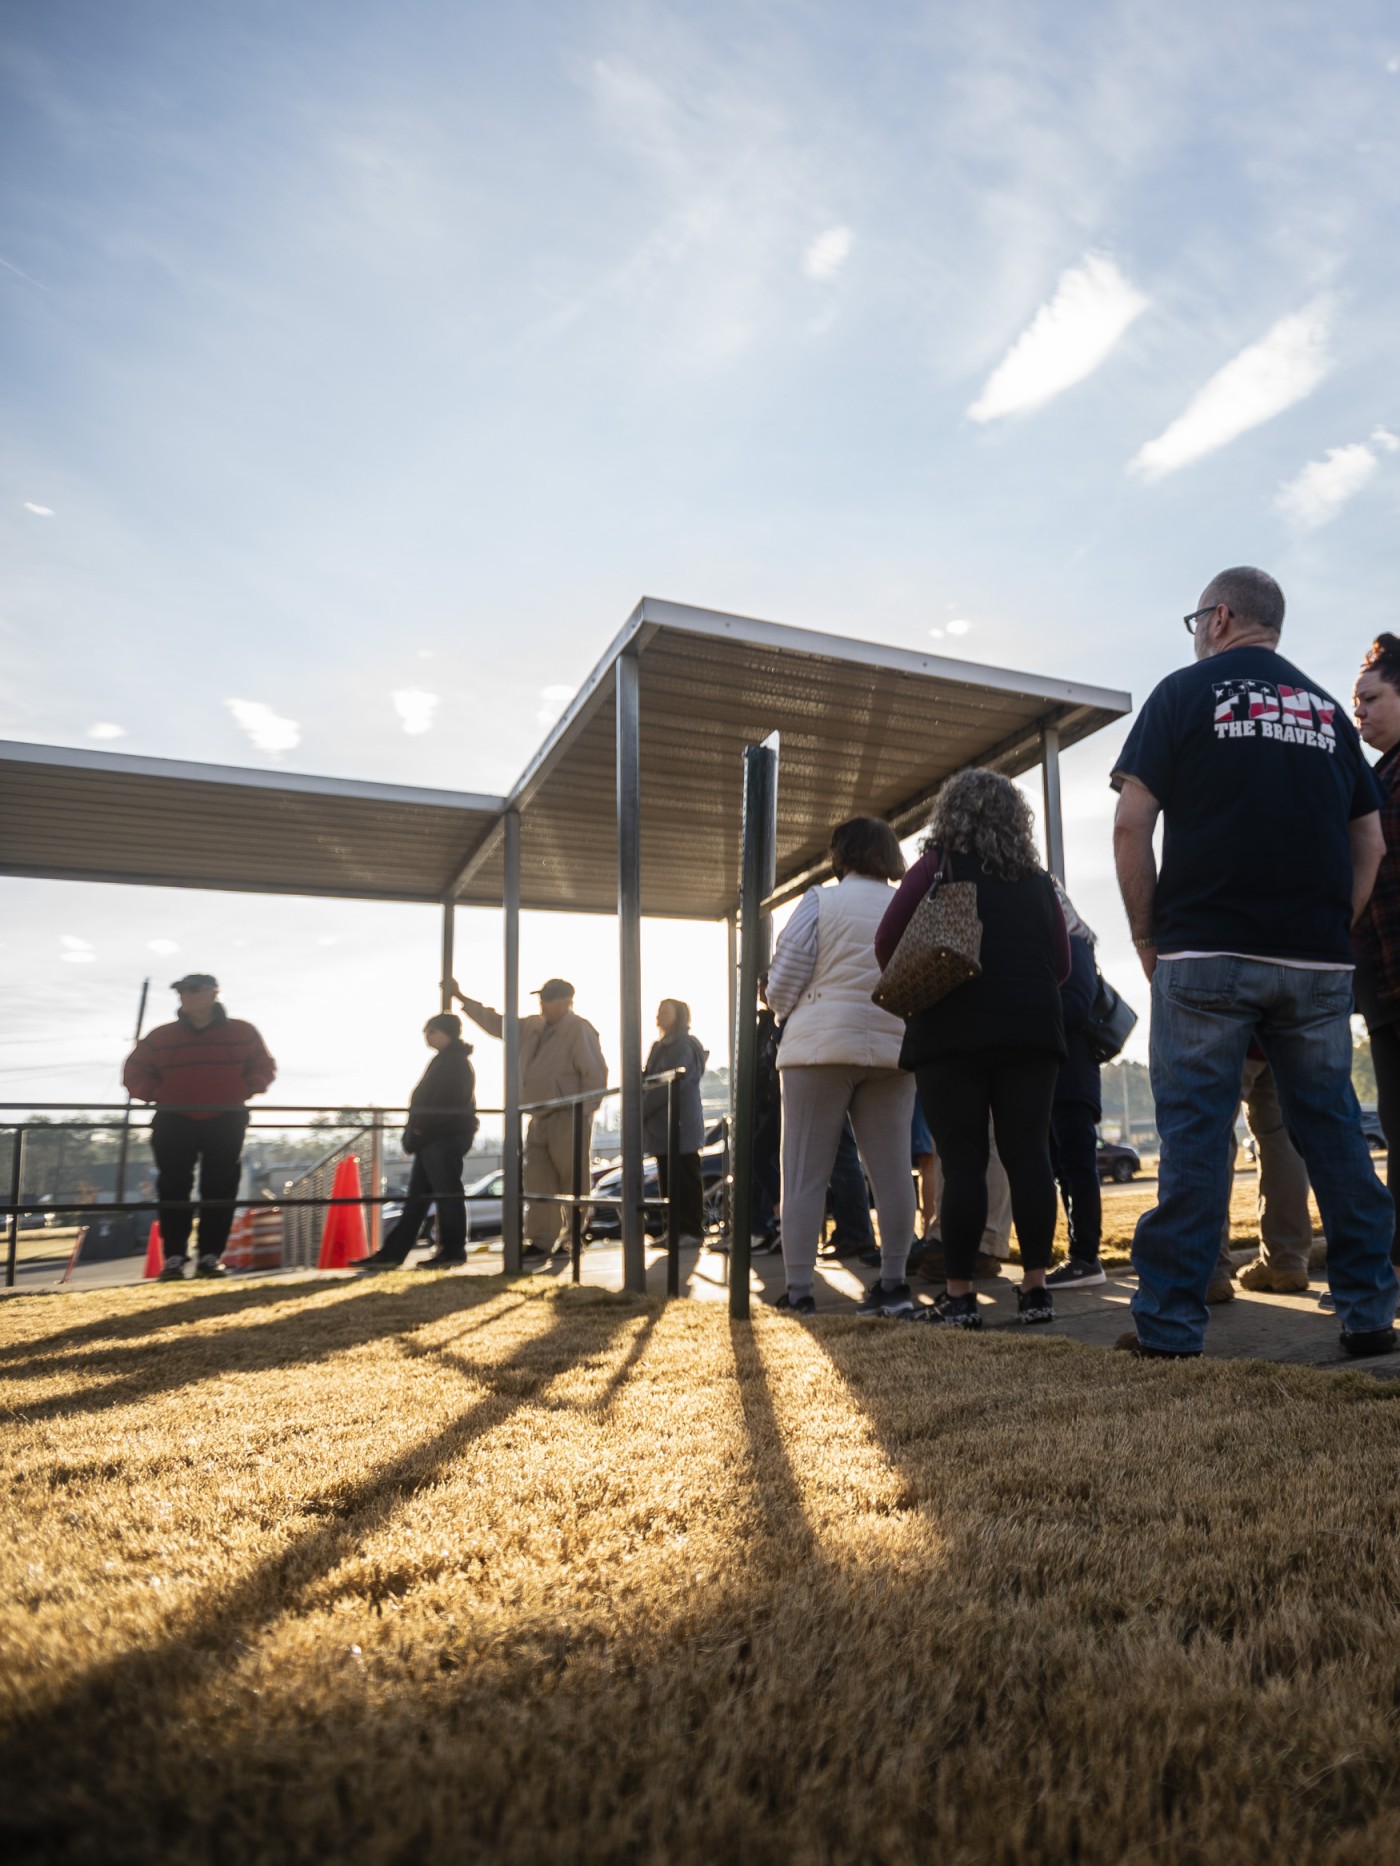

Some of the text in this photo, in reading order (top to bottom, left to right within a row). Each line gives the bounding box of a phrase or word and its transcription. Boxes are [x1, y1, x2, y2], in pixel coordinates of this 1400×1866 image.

[1212, 679, 1336, 738] FDNY
[1214, 720, 1336, 754] THE BRAVEST
